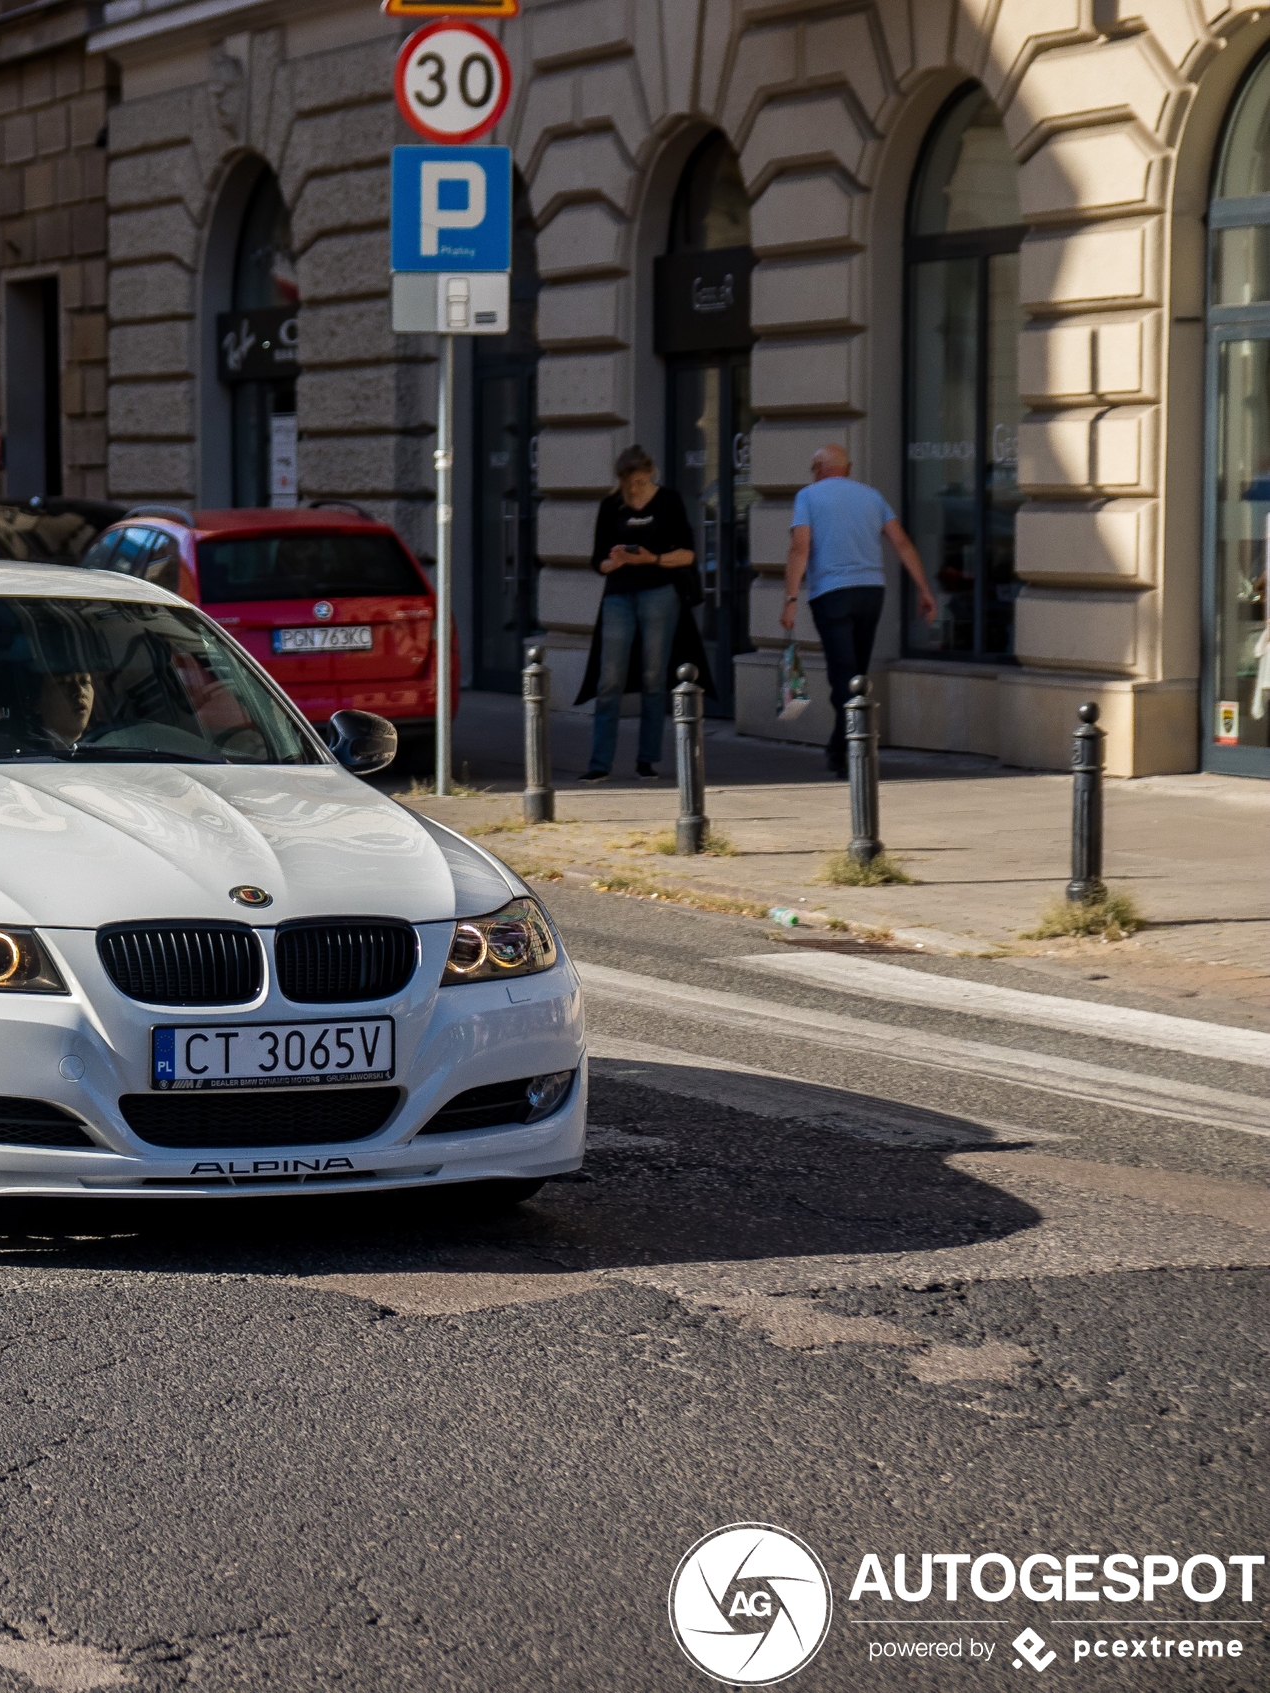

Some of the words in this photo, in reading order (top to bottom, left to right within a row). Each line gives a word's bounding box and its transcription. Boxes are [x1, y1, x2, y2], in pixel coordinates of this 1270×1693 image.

[414, 51, 494, 109] 30
[420, 160, 487, 257] P
[282, 629, 315, 648] PGN
[319, 627, 371, 646] 763KC
[185, 1031, 239, 1075] CT
[258, 1025, 381, 1072] 3065V
[157, 1061, 173, 1073] PL
[211, 1079, 239, 1087] DEALER
[240, 1078, 258, 1086] BMW
[258, 1077, 290, 1085] DYNAMIC
[291, 1075, 320, 1084] MOTORS
[190, 1157, 355, 1175] ALPINA
